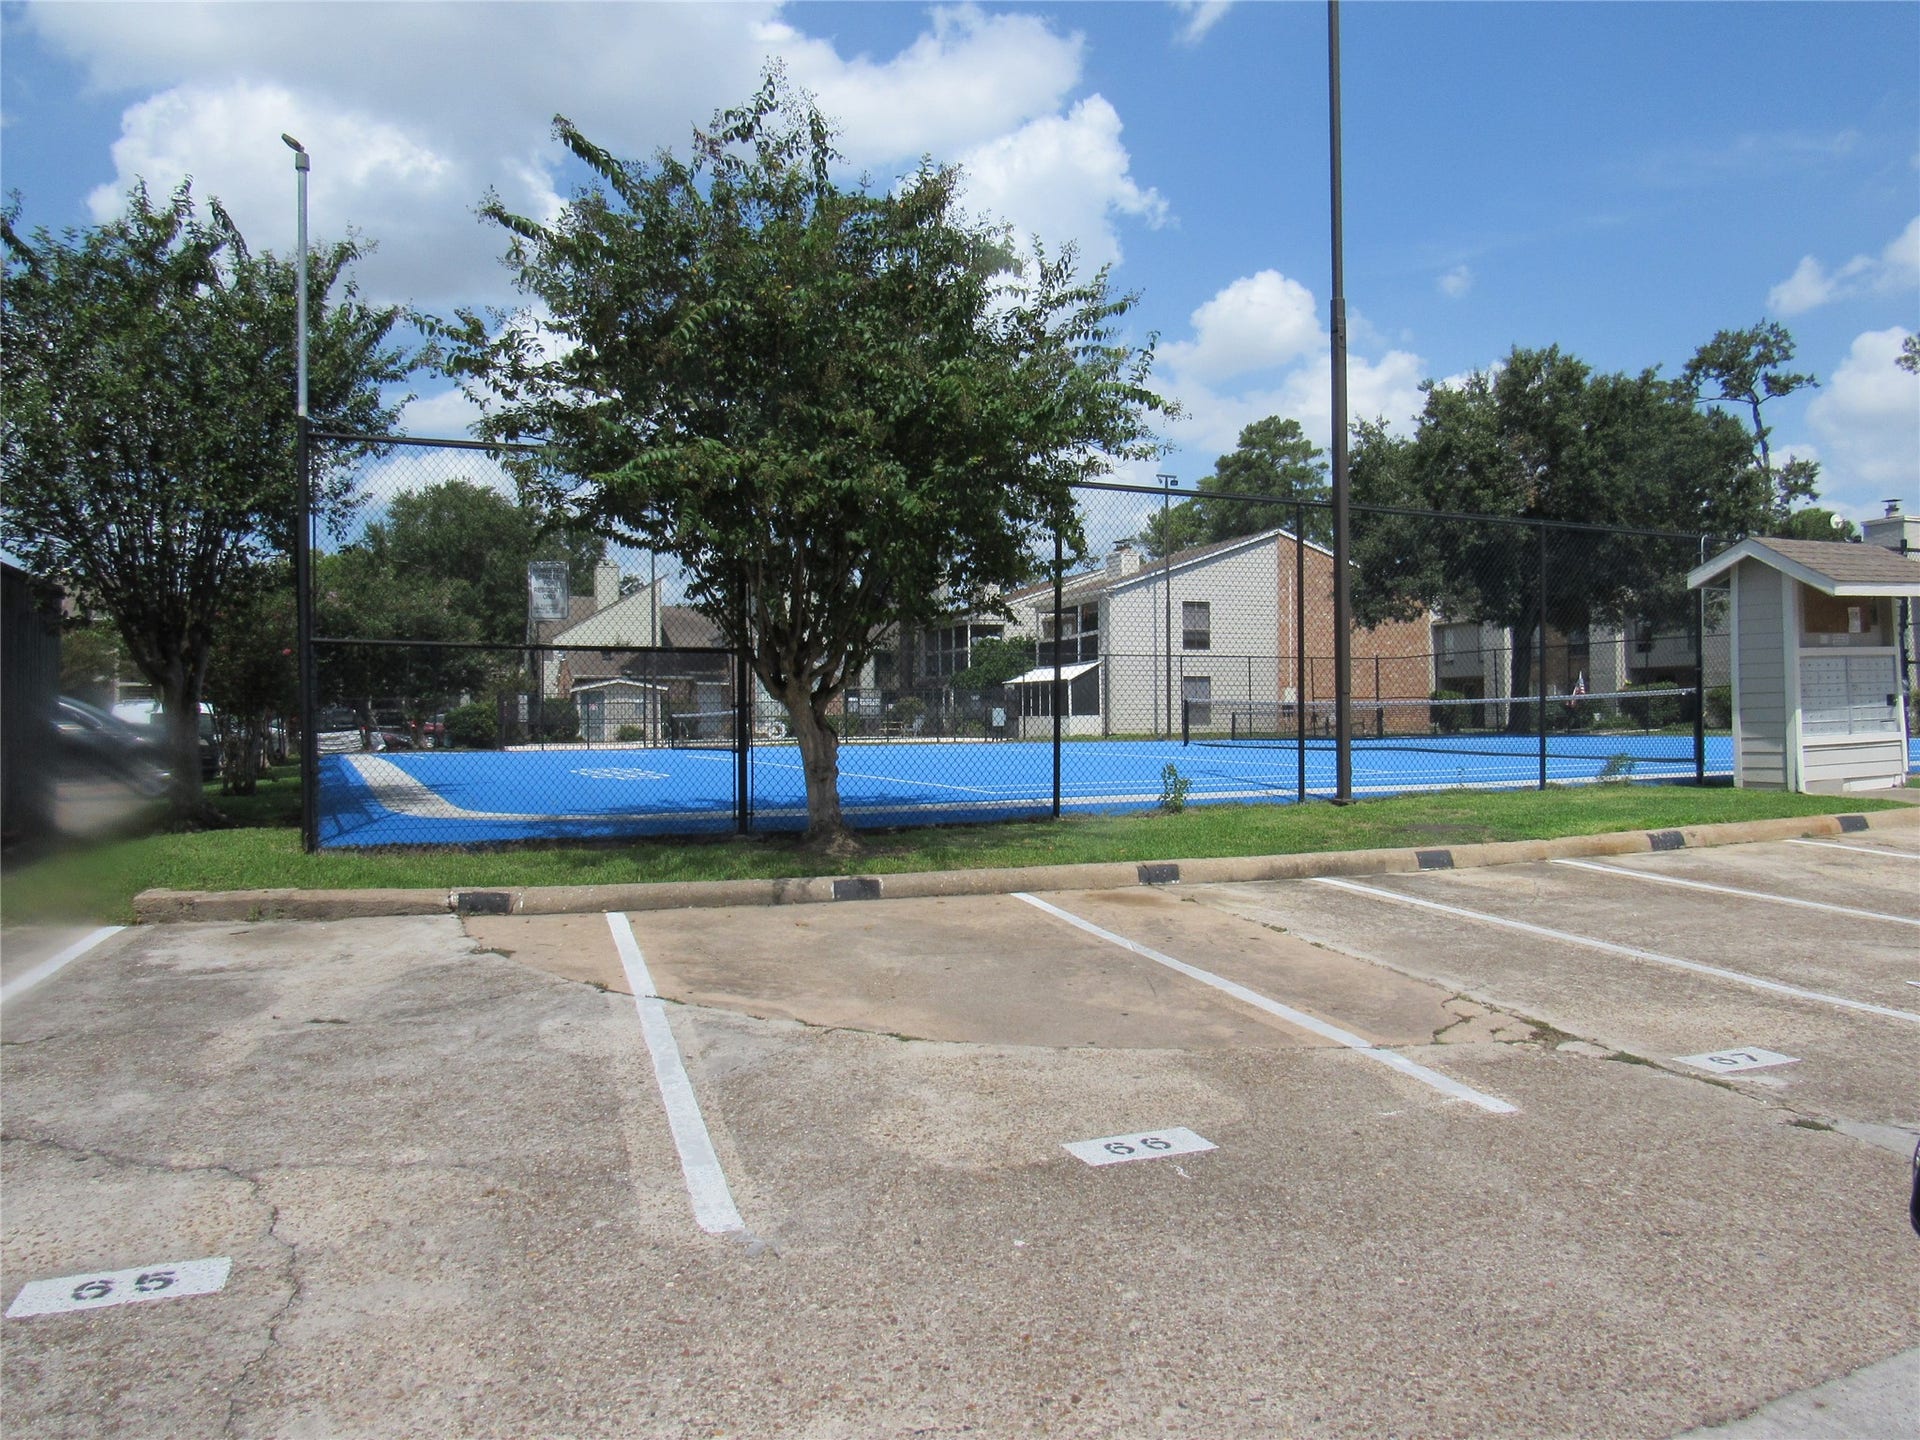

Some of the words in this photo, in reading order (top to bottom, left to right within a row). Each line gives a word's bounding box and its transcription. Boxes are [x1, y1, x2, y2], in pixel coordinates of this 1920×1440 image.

[1708, 1052, 1758, 1066] 67
[1103, 1137, 1172, 1155] 66
[70, 1270, 177, 1301] 65
